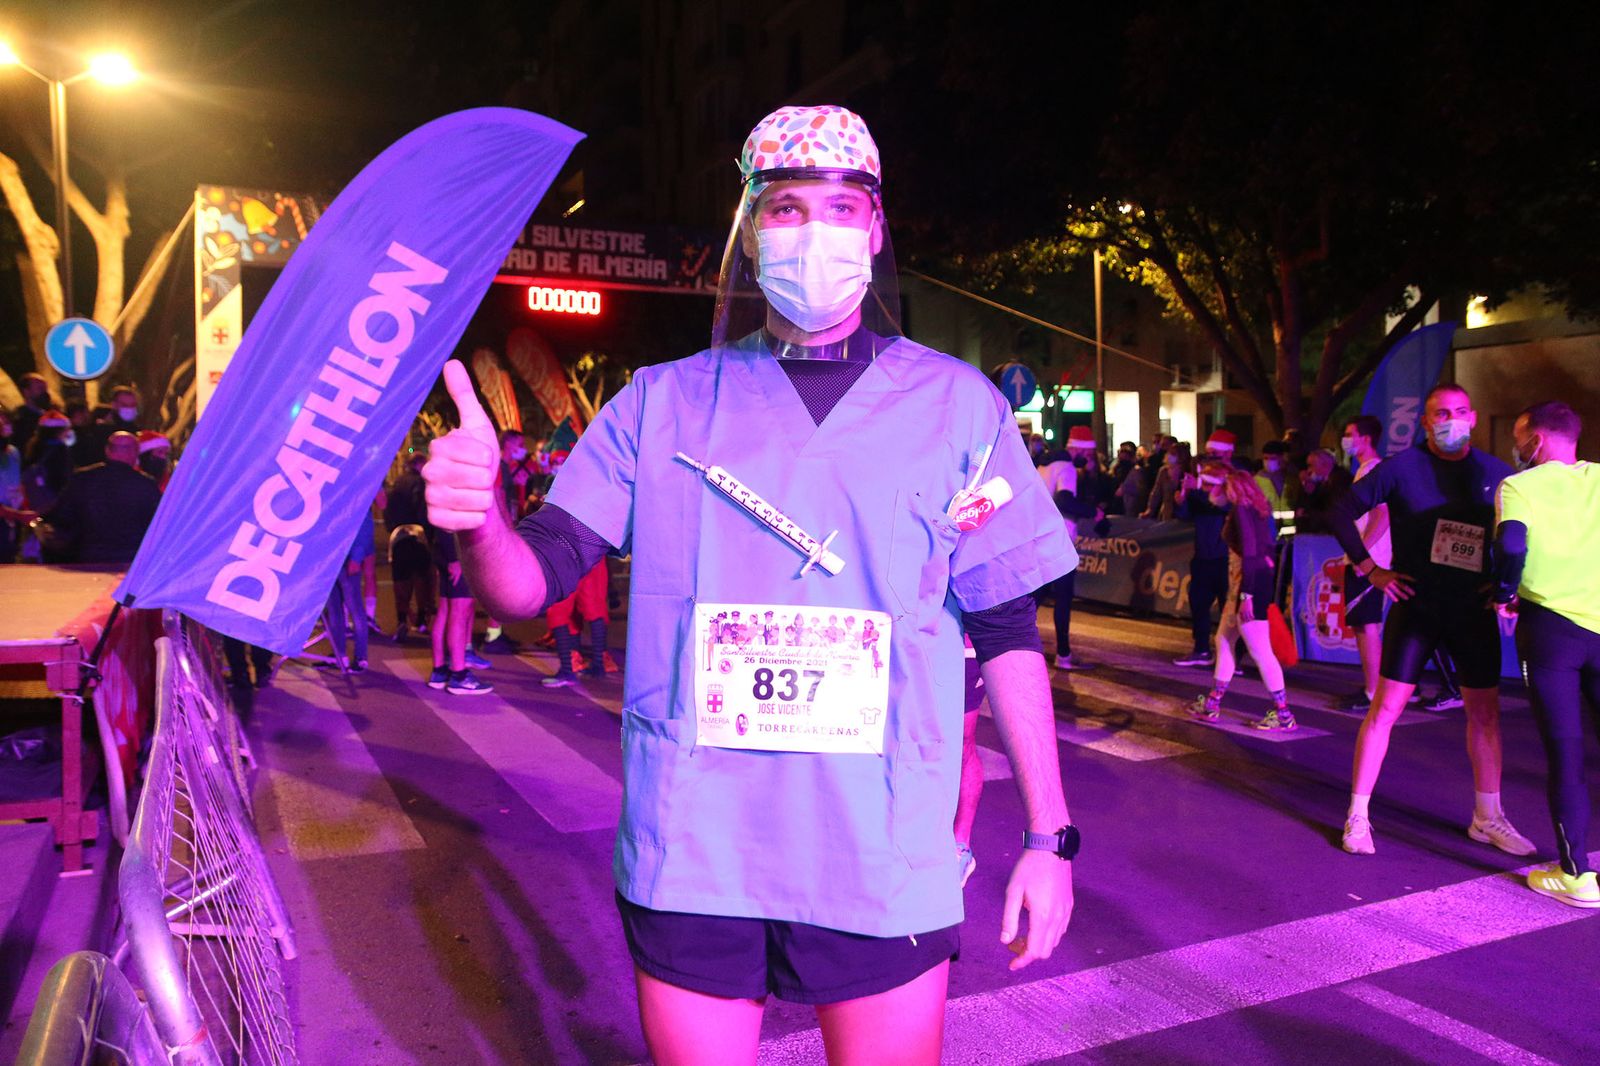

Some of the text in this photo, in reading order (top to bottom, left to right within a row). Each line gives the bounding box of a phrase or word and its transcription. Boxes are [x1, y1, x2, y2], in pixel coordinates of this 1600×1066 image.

[532, 225, 646, 253] SILVESTRE
[503, 244, 668, 281] AD DE ALMERÍA
[528, 286, 601, 315] 000000
[205, 240, 449, 622] DECATHLON
[1386, 396, 1420, 454] LON
[1451, 542, 1475, 557] 699
[744, 656, 828, 667] 26 Diciembre 2021
[753, 667, 825, 703] 837
[778, 703, 813, 716] VICENTE
